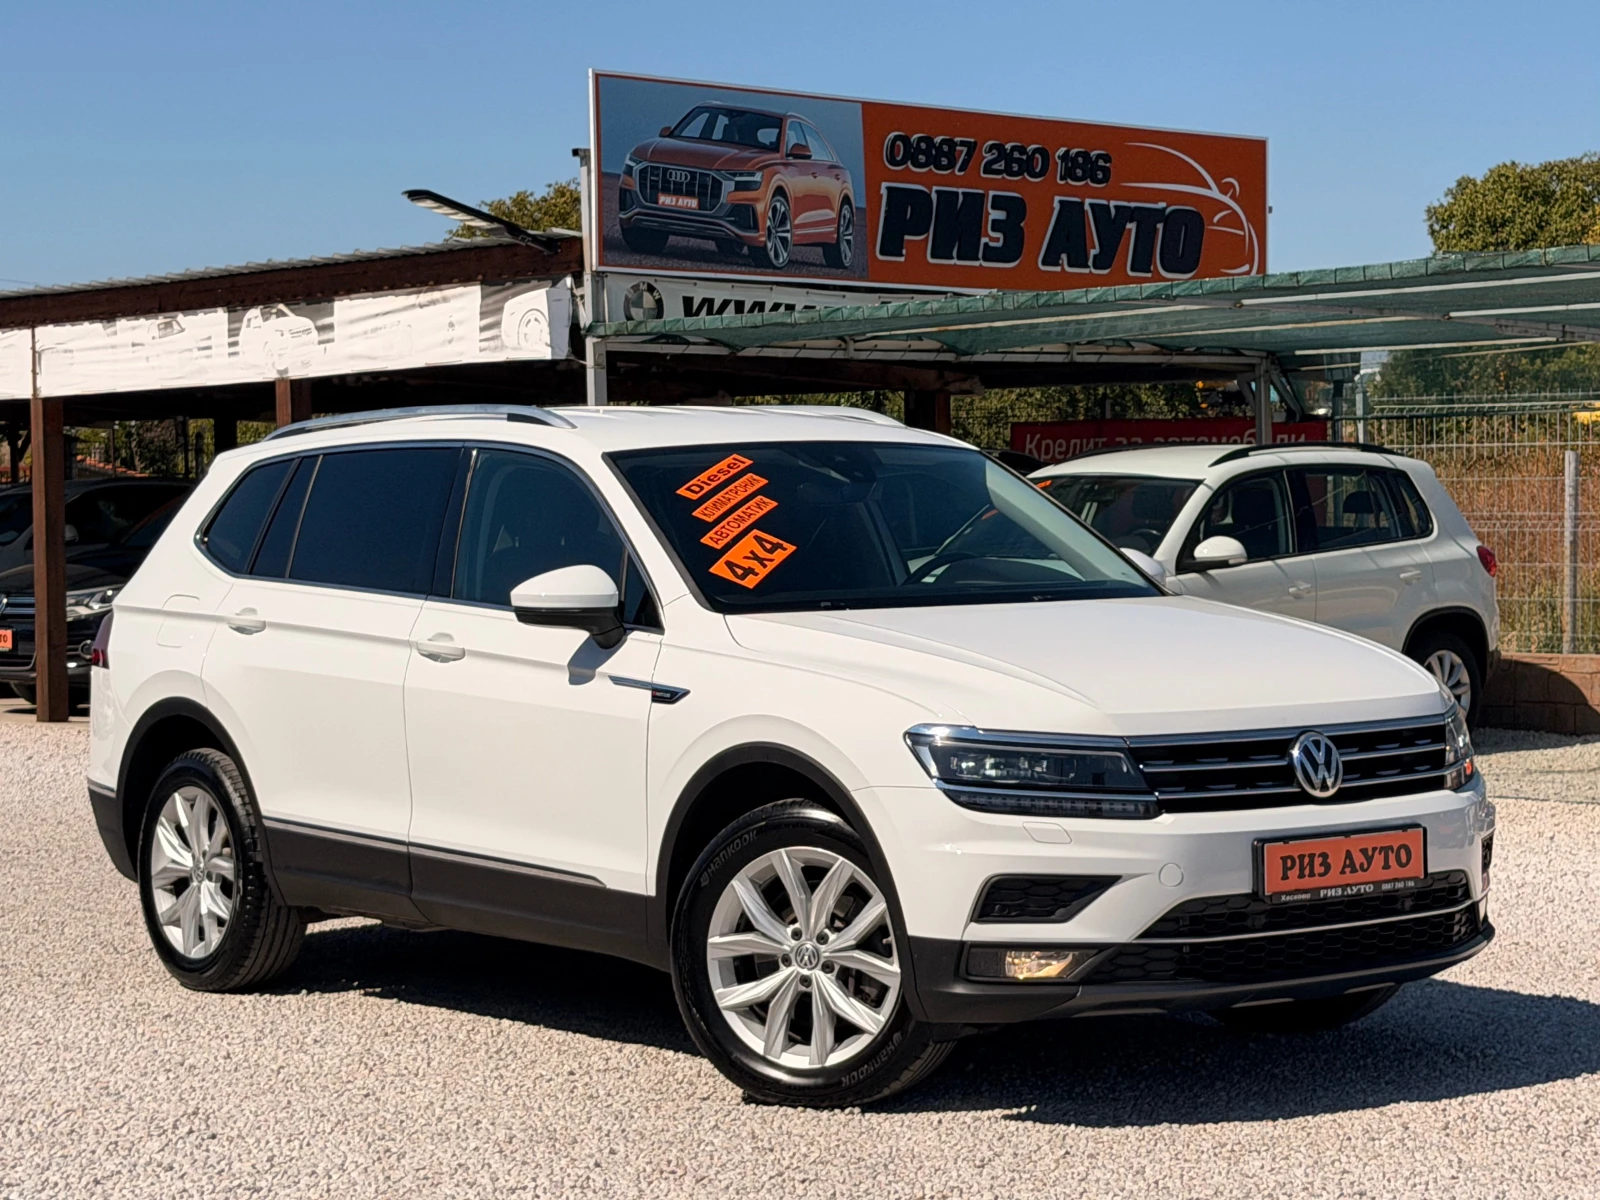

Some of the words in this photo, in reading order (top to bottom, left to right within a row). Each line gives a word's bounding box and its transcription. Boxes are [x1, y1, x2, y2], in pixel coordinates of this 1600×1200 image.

[884, 132, 977, 175] 0887
[981, 142, 1050, 181] 260
[1056, 147, 1112, 186] 186
[660, 195, 676, 205] РИЗ
[677, 197, 697, 207] АУТО
[877, 182, 1027, 268] РИЗ
[1038, 196, 1205, 279] АУТО
[685, 457, 747, 495] Diesel
[699, 475, 761, 519] КЛИМАТРОНИК
[708, 498, 771, 545] АВТОМАТИК
[1280, 852, 1332, 880] РИЗ
[1339, 844, 1412, 875] АУТО
[1320, 888, 1342, 898] РИЗ
[1344, 884, 1374, 895] АУТО
